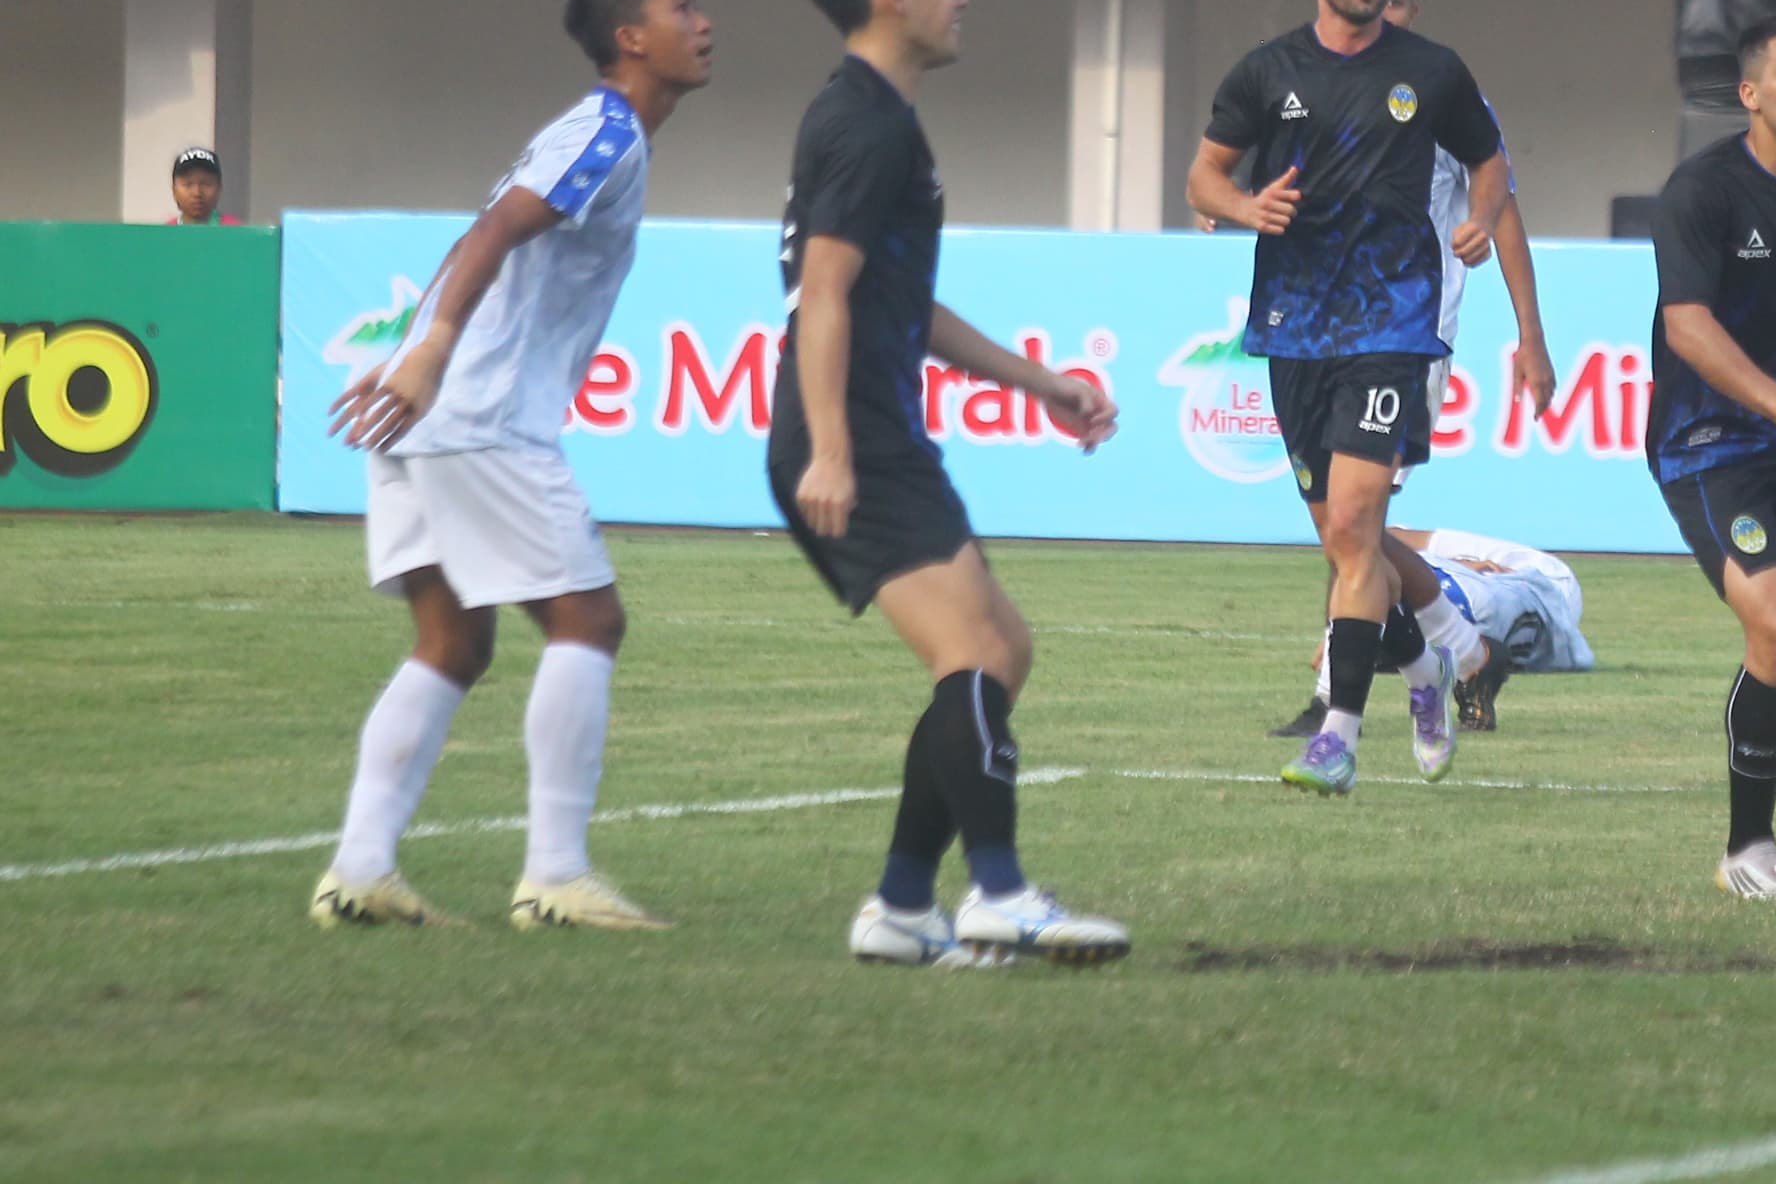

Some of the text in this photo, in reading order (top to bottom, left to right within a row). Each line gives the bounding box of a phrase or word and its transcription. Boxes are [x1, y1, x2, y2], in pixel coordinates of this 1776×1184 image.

[1280, 109, 1310, 120] apex
[565, 351, 630, 428] e
[1231, 382, 1262, 410] Le
[1364, 387, 1400, 423] 10
[1189, 408, 1283, 435] Minera
[1358, 418, 1391, 435] apex
